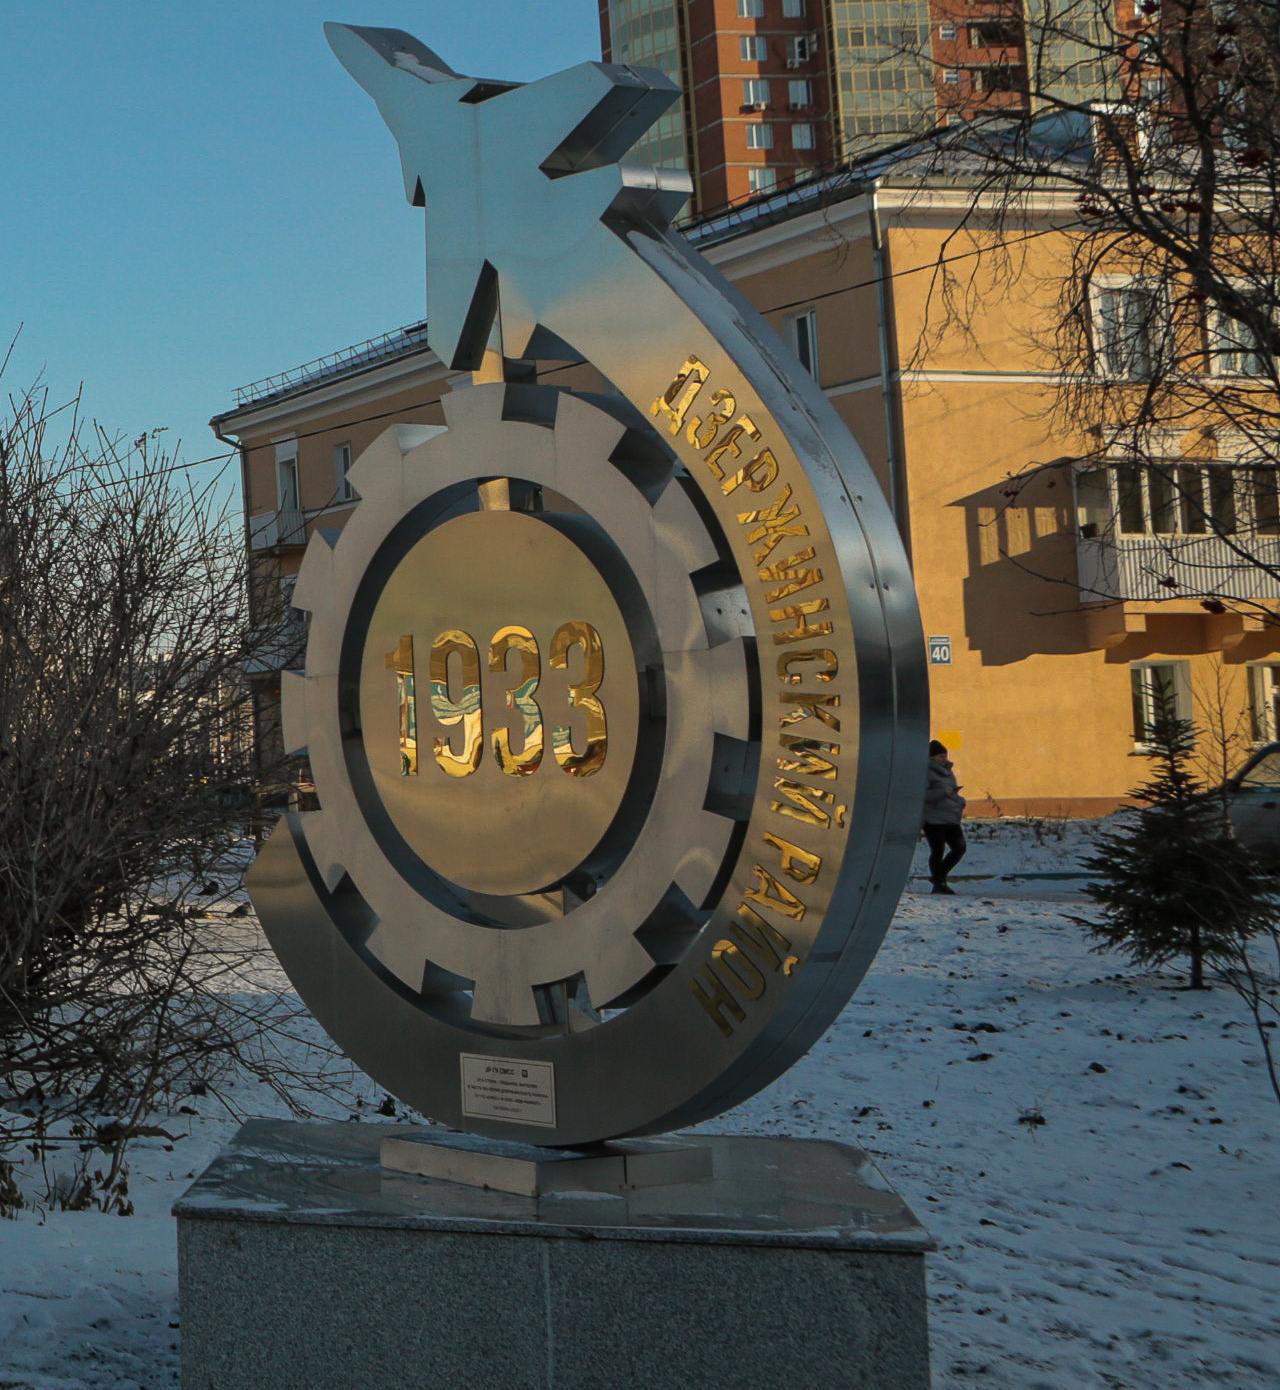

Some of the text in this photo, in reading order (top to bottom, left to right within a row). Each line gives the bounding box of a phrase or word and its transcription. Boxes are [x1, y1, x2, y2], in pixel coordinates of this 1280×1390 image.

[384, 621, 608, 778] 1933
[651, 354, 847, 1038] ДЗЕРЖИНСКИЙ РАЙОН
[932, 645, 949, 661] 40
